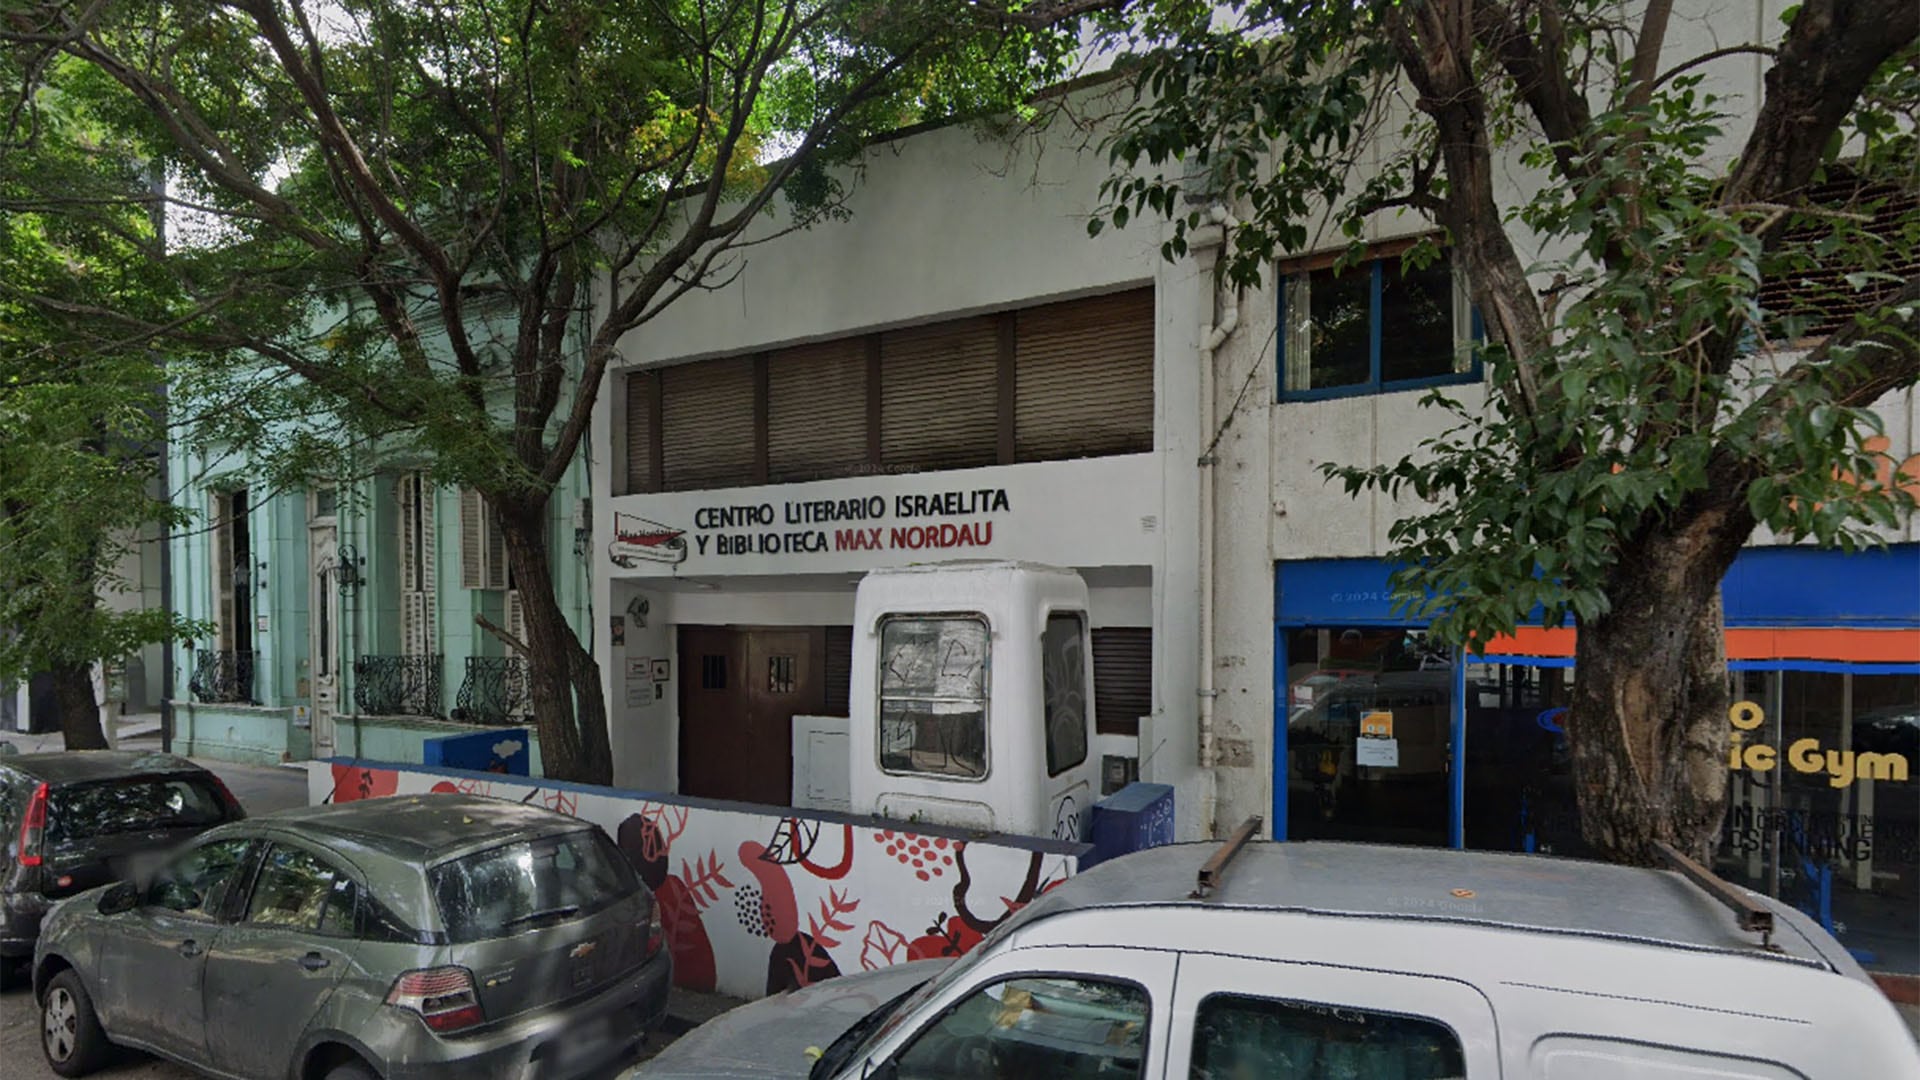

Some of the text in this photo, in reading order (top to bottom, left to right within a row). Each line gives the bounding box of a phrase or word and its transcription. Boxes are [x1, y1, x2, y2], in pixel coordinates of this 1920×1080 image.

[695, 489, 1010, 530] CENTRO LITERARIO ISRAELITA
[695, 534, 710, 556] Y
[717, 530, 829, 556] BIBLIOTECA
[835, 527, 883, 551] MAX
[890, 521, 993, 550] NORDAU
[1729, 700, 1765, 730] o
[1729, 732, 1909, 789] ic Gym
